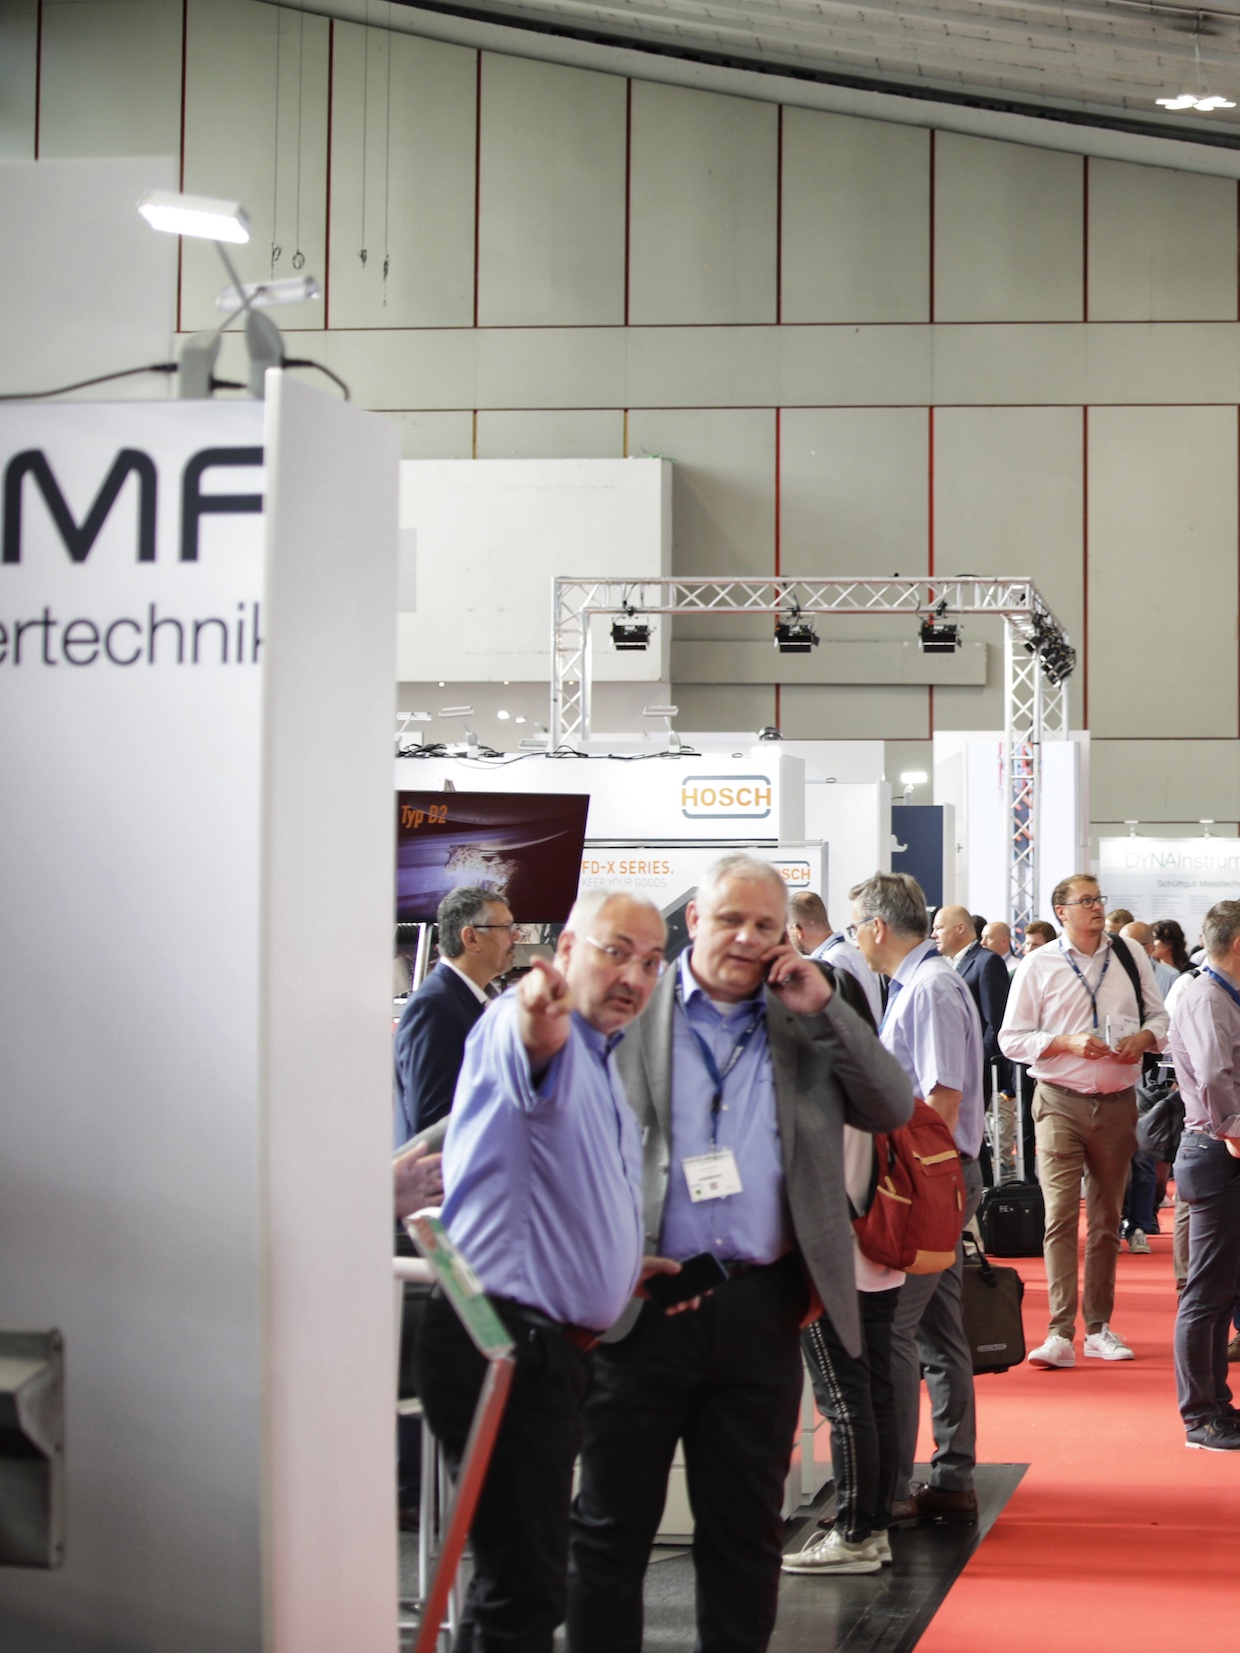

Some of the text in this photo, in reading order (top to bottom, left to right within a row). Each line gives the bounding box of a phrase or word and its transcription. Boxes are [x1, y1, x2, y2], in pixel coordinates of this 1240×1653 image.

[0, 602, 263, 666] rtechni
[681, 787, 772, 807] HOSCH
[401, 804, 449, 829] Typ D2
[619, 861, 675, 875] SERIES.
